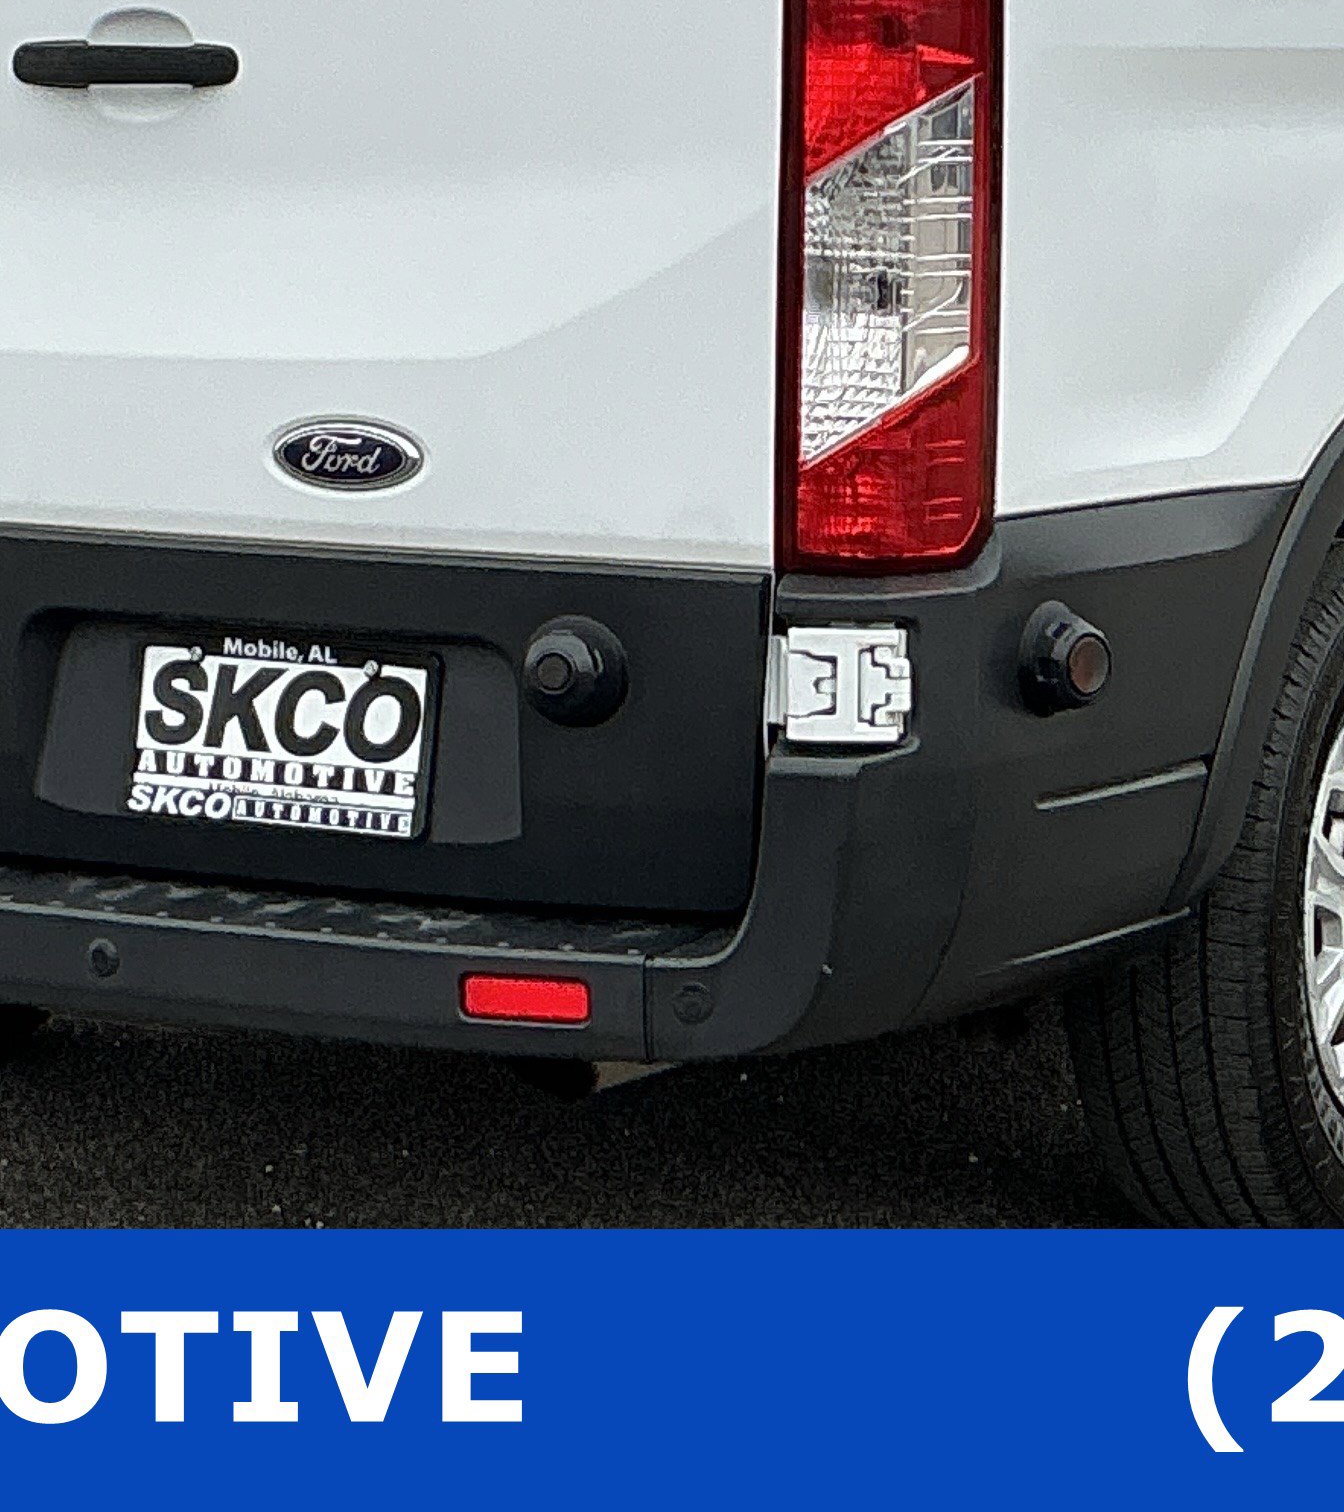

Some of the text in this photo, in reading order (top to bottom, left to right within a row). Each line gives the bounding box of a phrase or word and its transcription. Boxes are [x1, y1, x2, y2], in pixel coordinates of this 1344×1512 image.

[301, 435, 382, 474] Ford
[222, 636, 338, 664] Mobile, AL
[144, 658, 422, 764] SKCO
[138, 748, 415, 796] AUTOMOTIVE
[126, 784, 413, 834] SKCO AUTOMOTIVE
